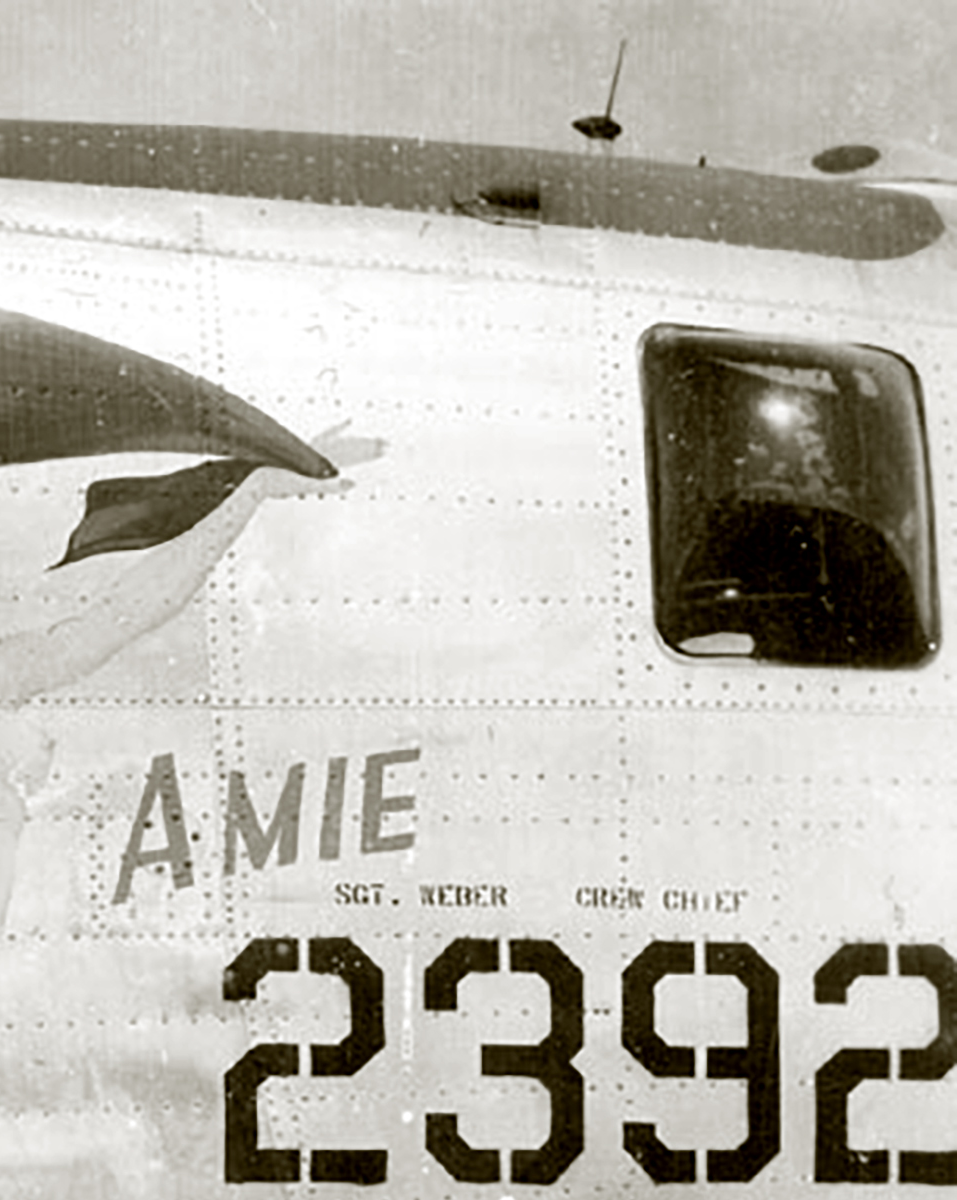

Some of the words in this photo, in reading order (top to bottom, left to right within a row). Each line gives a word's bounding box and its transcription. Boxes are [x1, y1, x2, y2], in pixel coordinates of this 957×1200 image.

[111, 748, 421, 905] AMIE
[334, 883, 400, 906] SGT.
[418, 883, 508, 908] WEBER
[575, 885, 645, 910] CREW
[223, 937, 956, 1185] 2392
